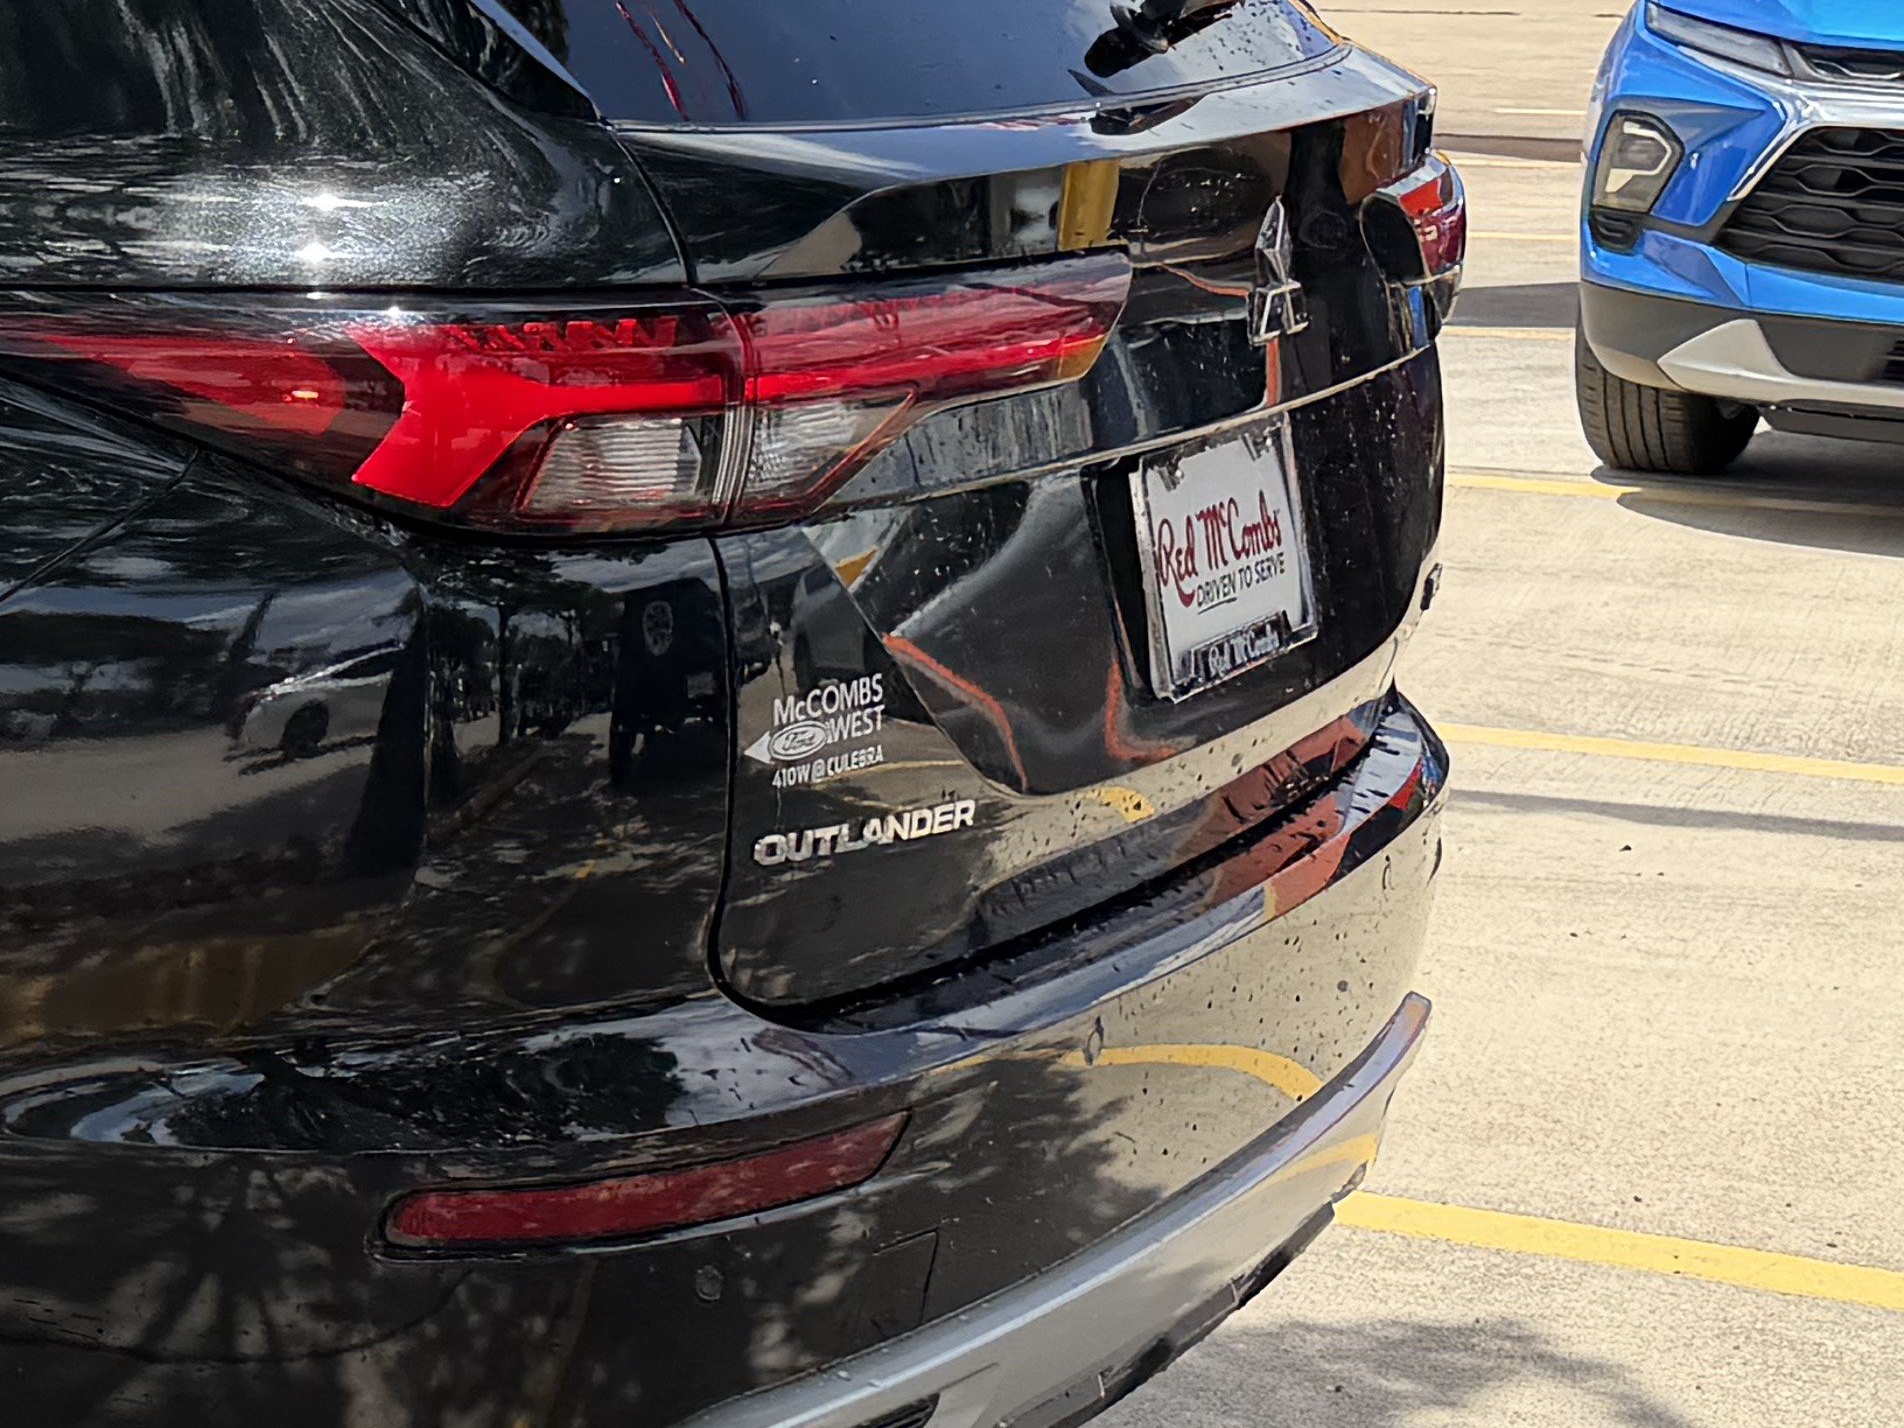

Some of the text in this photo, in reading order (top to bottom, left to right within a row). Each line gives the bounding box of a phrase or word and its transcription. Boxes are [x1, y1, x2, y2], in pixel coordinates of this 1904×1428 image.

[1154, 515, 1199, 608] Red
[1196, 552, 1286, 608] DRIVEN TO SERVE
[772, 673, 885, 727] McCOMBS
[753, 799, 976, 866] OUTLANDER
